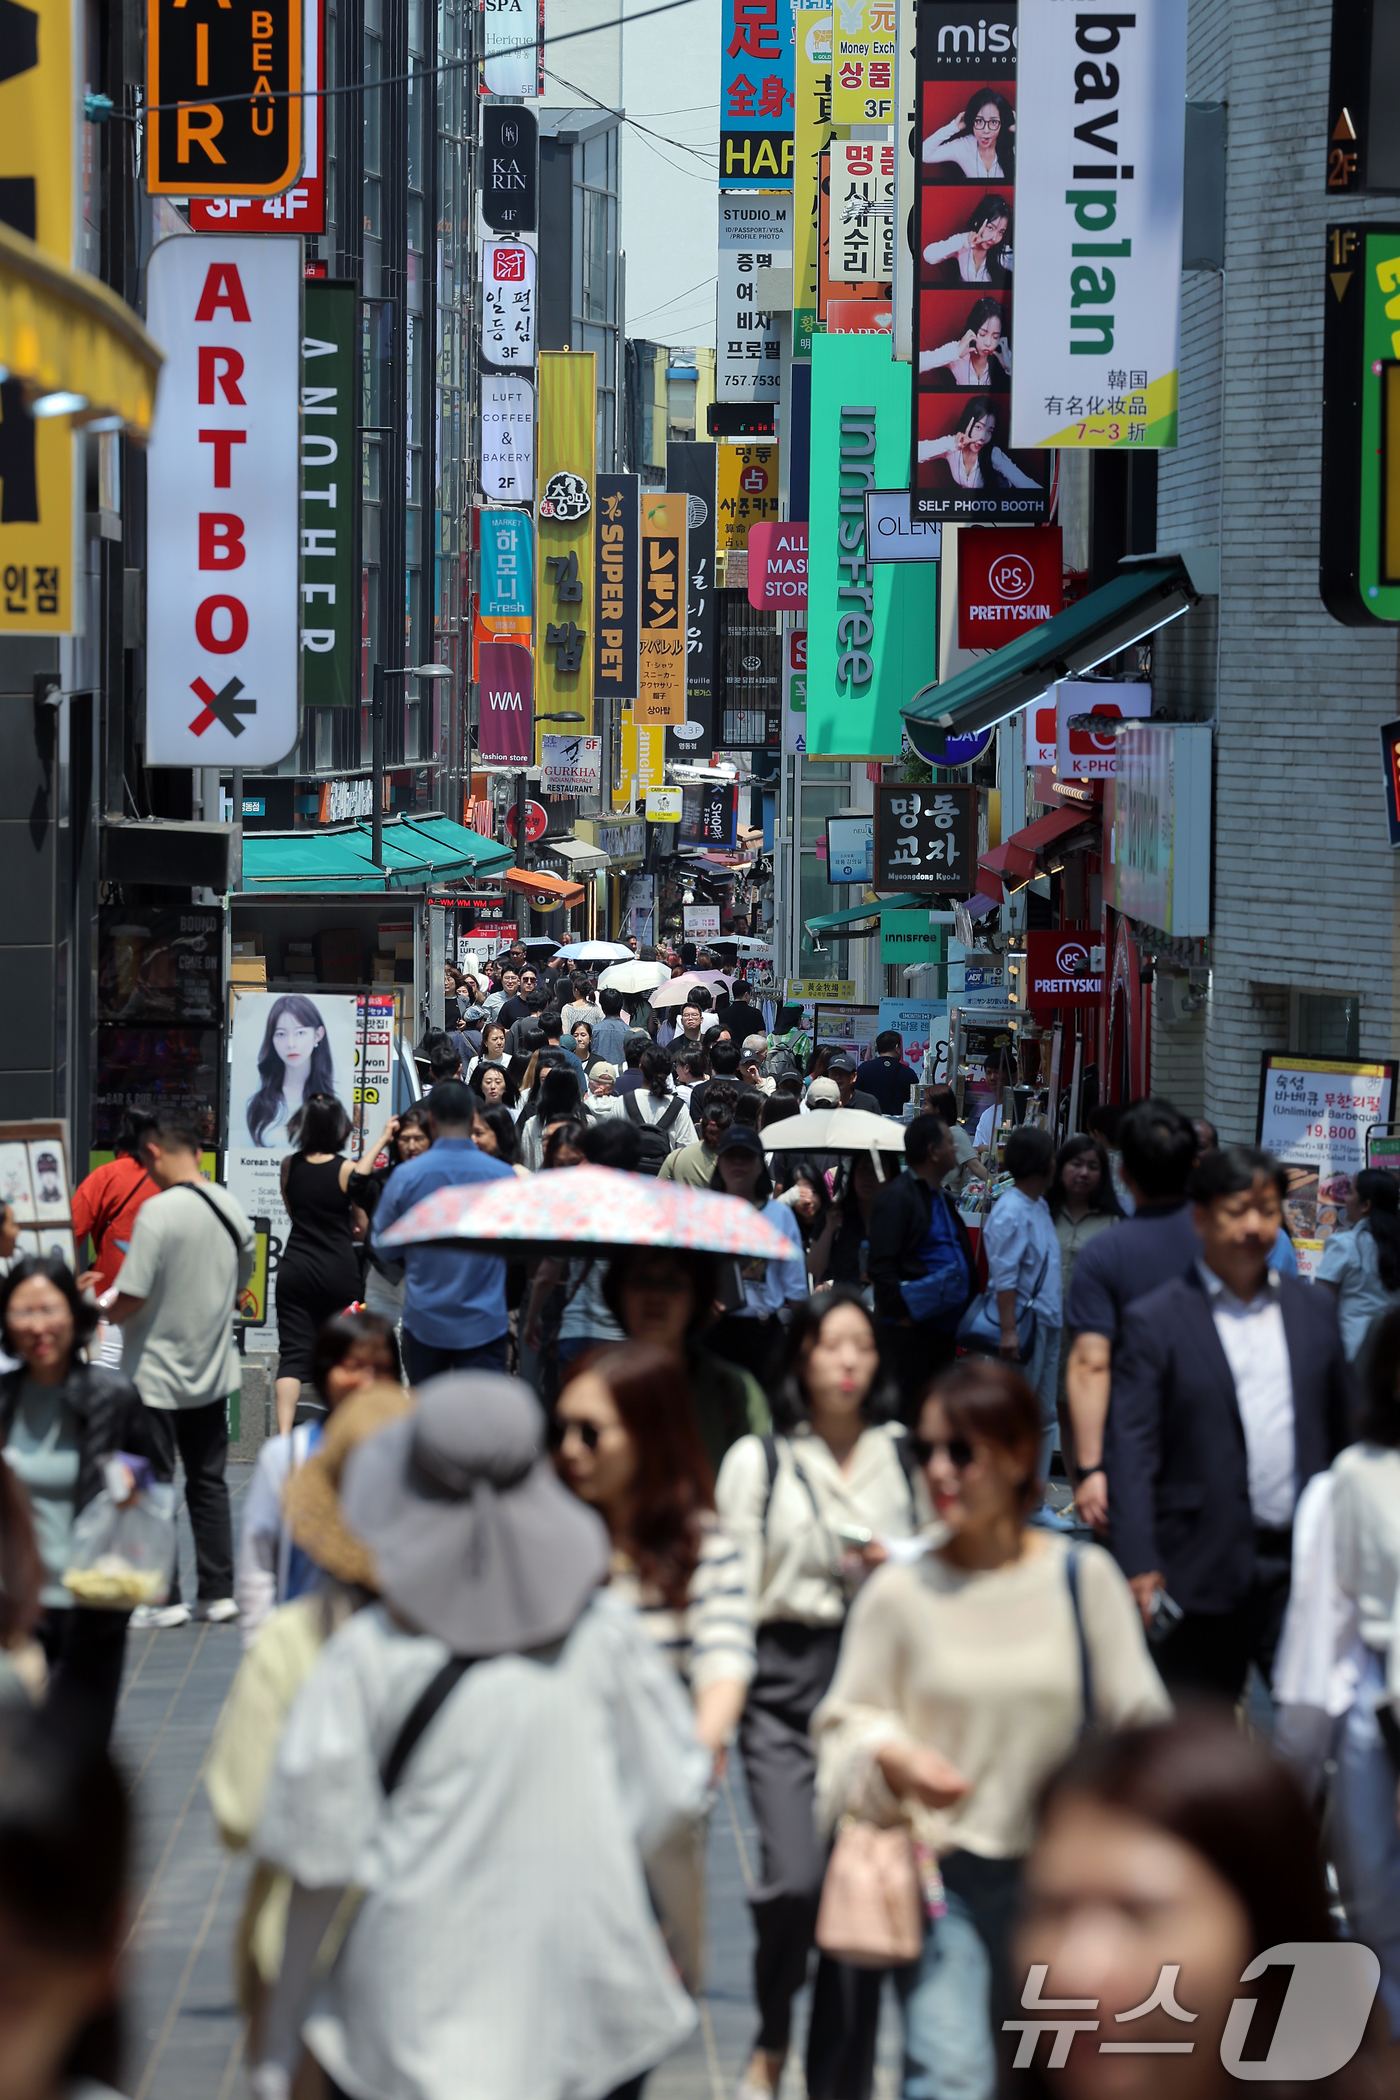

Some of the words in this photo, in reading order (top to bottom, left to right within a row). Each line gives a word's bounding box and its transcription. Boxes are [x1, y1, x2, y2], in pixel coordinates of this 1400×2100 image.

[485, 0, 522, 12] SPA
[727, 0, 782, 59] 足
[937, 19, 1018, 53] mis
[486, 33, 533, 47] Herique
[840, 41, 870, 56] Money
[873, 41, 895, 54] Exch
[250, 11, 275, 136] BEAU
[839, 62, 891, 89] 상품
[174, 0, 232, 164] IR
[521, 85, 533, 94] 5F
[864, 99, 892, 118] 3F
[1328, 148, 1357, 186] 2F
[1065, 13, 1136, 355] baviplan
[262, 189, 309, 219] 4F
[501, 210, 517, 221] 4F
[723, 209, 787, 221] STUDIO_M
[1329, 229, 1356, 265] 1F
[736, 253, 772, 273] 증명
[736, 283, 757, 302] 여
[737, 312, 772, 331] 비자
[501, 347, 519, 358] 3F
[727, 341, 780, 360] 프로필
[1107, 369, 1148, 391] 韓国
[492, 393, 523, 402] LUFT
[1044, 396, 1148, 416] 有名化妆品
[483, 413, 532, 422] COFFEE
[501, 431, 512, 445] &
[1127, 421, 1147, 442] 折
[483, 453, 531, 462] BAKERY
[735, 447, 772, 464] 명동
[498, 477, 516, 489] 2F
[744, 469, 764, 491] 占
[301, 336, 338, 653] ANOTHER
[918, 500, 950, 512] SELF
[954, 500, 997, 512] PHOTO
[1001, 500, 1044, 512] BOOTH
[492, 519, 522, 527] MARKET
[878, 516, 942, 535] OLEN
[776, 536, 808, 551] ALL
[601, 524, 624, 620] SUPER
[767, 559, 808, 574] MAS
[647, 541, 677, 629] レモン
[489, 602, 525, 613] Fresh
[545, 550, 587, 672] 김밥
[495, 621, 516, 629] 명동점
[601, 629, 623, 682] PET
[643, 671, 676, 680] スニーカー
[489, 691, 523, 711] WM
[653, 692, 667, 700] 帽子
[647, 706, 671, 715] 상아탑
[585, 740, 598, 750] 5F
[679, 742, 697, 750] 명동점
[482, 752, 508, 761] fashion
[509, 754, 528, 762] store
[639, 727, 655, 789] amelin
[1039, 749, 1056, 760] K-
[544, 765, 597, 778] GURKHA
[546, 784, 594, 793] RESTAURANT
[890, 793, 960, 829] 명동
[888, 833, 960, 867] 교자
[888, 873, 934, 882] Myeongdong
[457, 899, 471, 907] WM
[473, 899, 487, 907] WM
[891, 1021, 918, 1032] 한달용
[1276, 1074, 1305, 1091] 숙성
[1275, 1091, 1319, 1106] 바베큐
[1324, 1093, 1381, 1112] 무한리필
[1273, 1104, 1324, 1118] (Unlimited
[1328, 1110, 1382, 1123] Barbeque)
[1306, 1124, 1357, 1140] 19,800
[241, 1157, 268, 1166] Korean
[258, 1187, 277, 1196] Scalp
[257, 1207, 271, 1215] Hair
